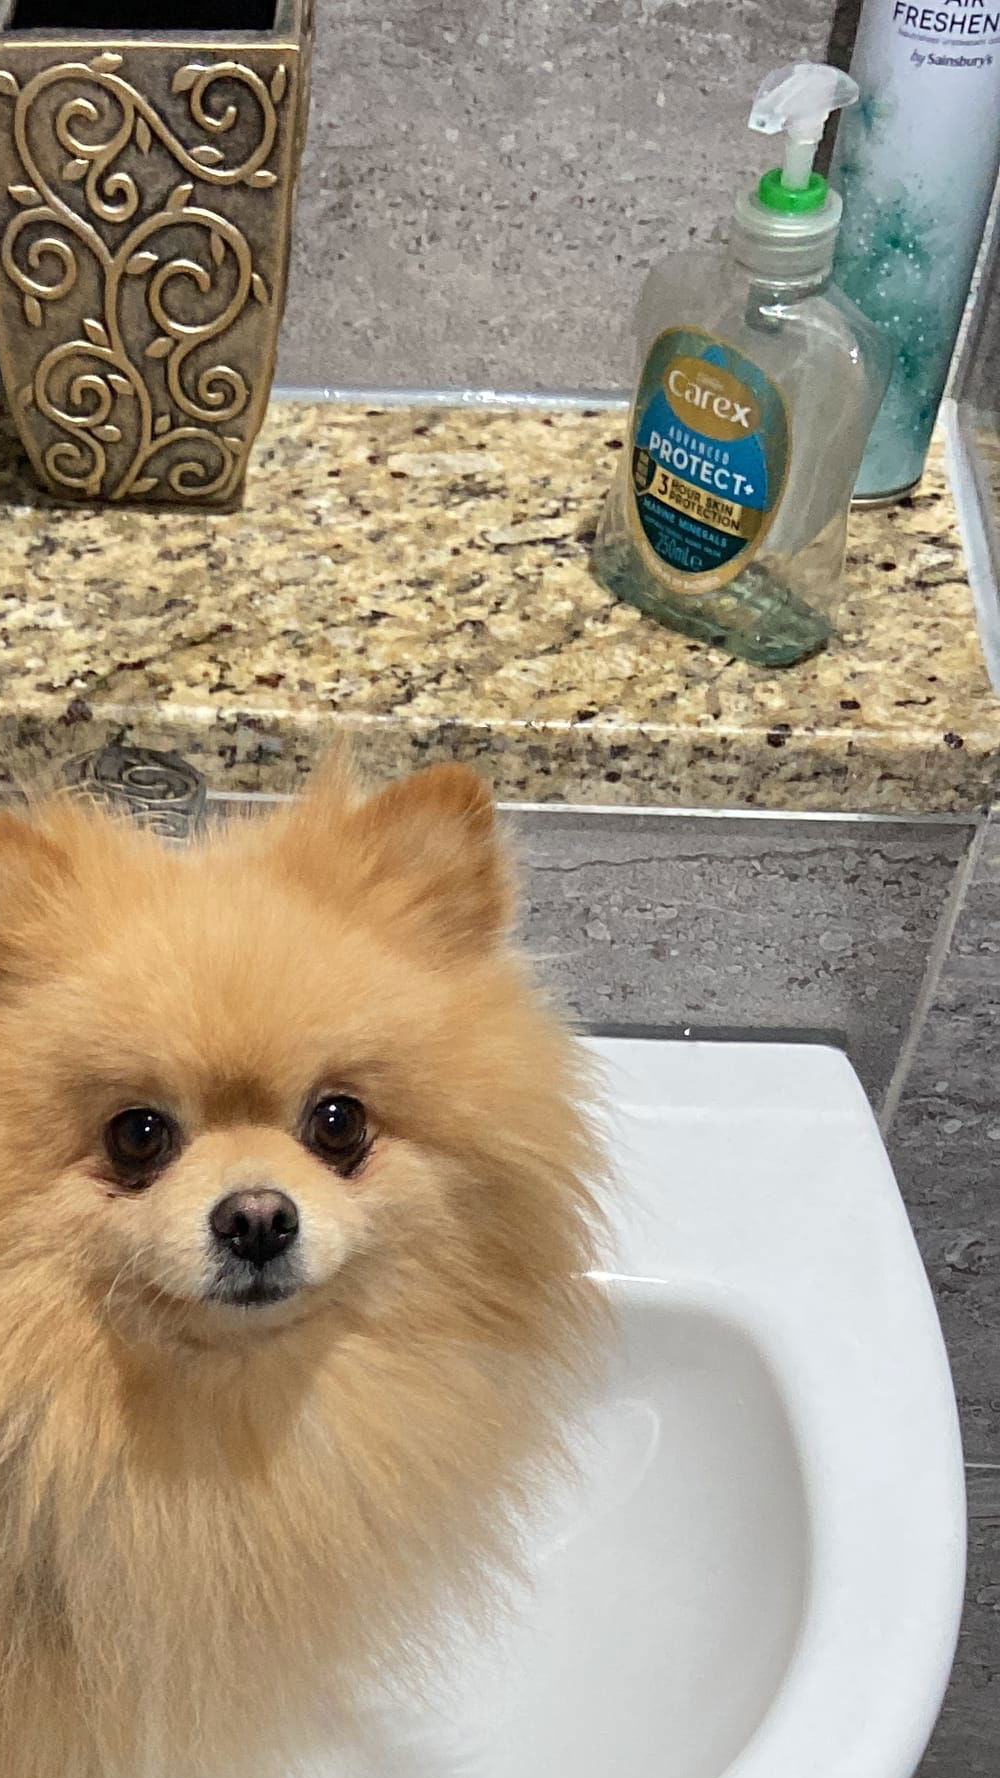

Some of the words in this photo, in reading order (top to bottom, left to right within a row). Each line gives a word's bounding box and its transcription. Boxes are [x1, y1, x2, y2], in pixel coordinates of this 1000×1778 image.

[910, 49, 926, 68] by
[927, 53, 993, 69] Sainsbury's
[668, 370, 751, 428] Carex
[649, 430, 754, 495] PROTECT+
[669, 425, 729, 465] ADVANCED
[657, 473, 670, 495] 3
[671, 479, 702, 501] HOUR
[705, 495, 734, 516] SKIN
[668, 490, 740, 531] PROTECTION
[678, 518, 728, 548] MINERALS
